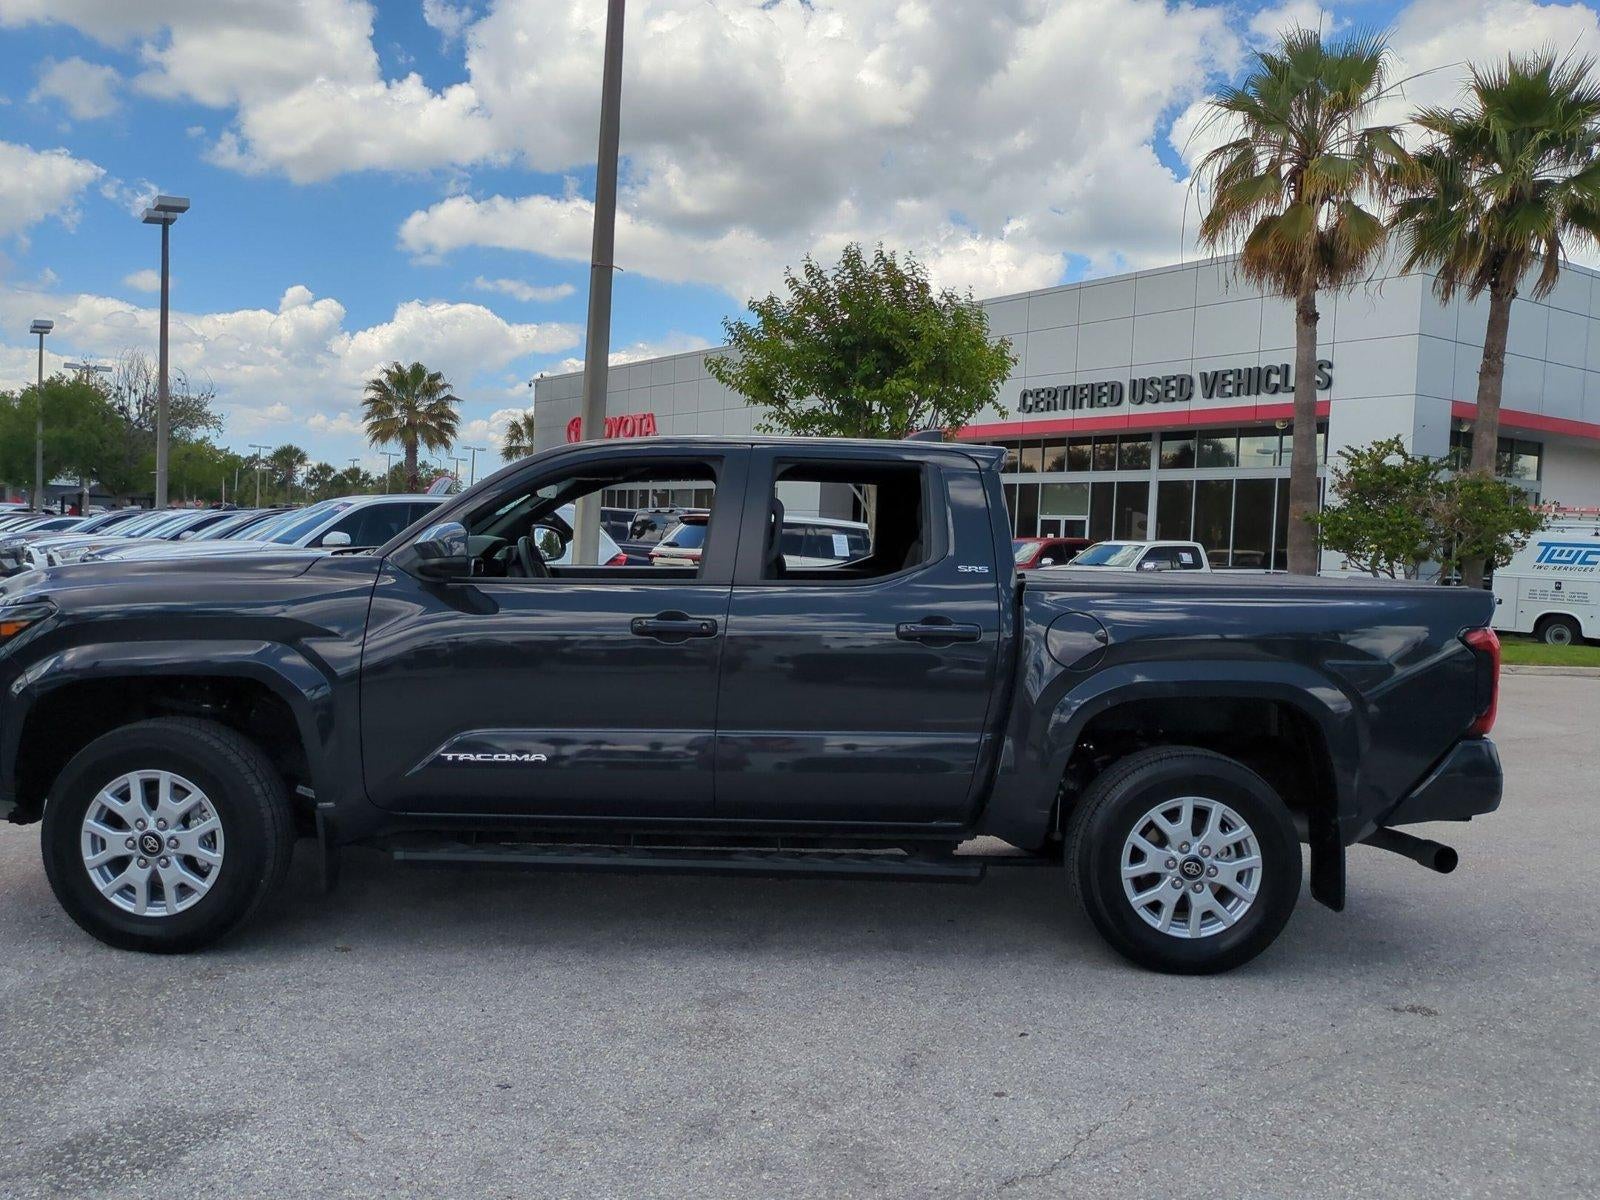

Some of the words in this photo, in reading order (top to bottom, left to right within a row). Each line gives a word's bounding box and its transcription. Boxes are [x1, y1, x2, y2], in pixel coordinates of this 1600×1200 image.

[1018, 380, 1122, 413] CERTIFIED
[1128, 374, 1193, 405] USED
[1200, 360, 1333, 399] VEHICLS
[602, 413, 658, 438] OYOTA
[1536, 542, 1600, 565] TWC
[957, 565, 989, 573] SR5
[1552, 565, 1595, 573] SERVICES
[440, 753, 548, 761] TACOMA
